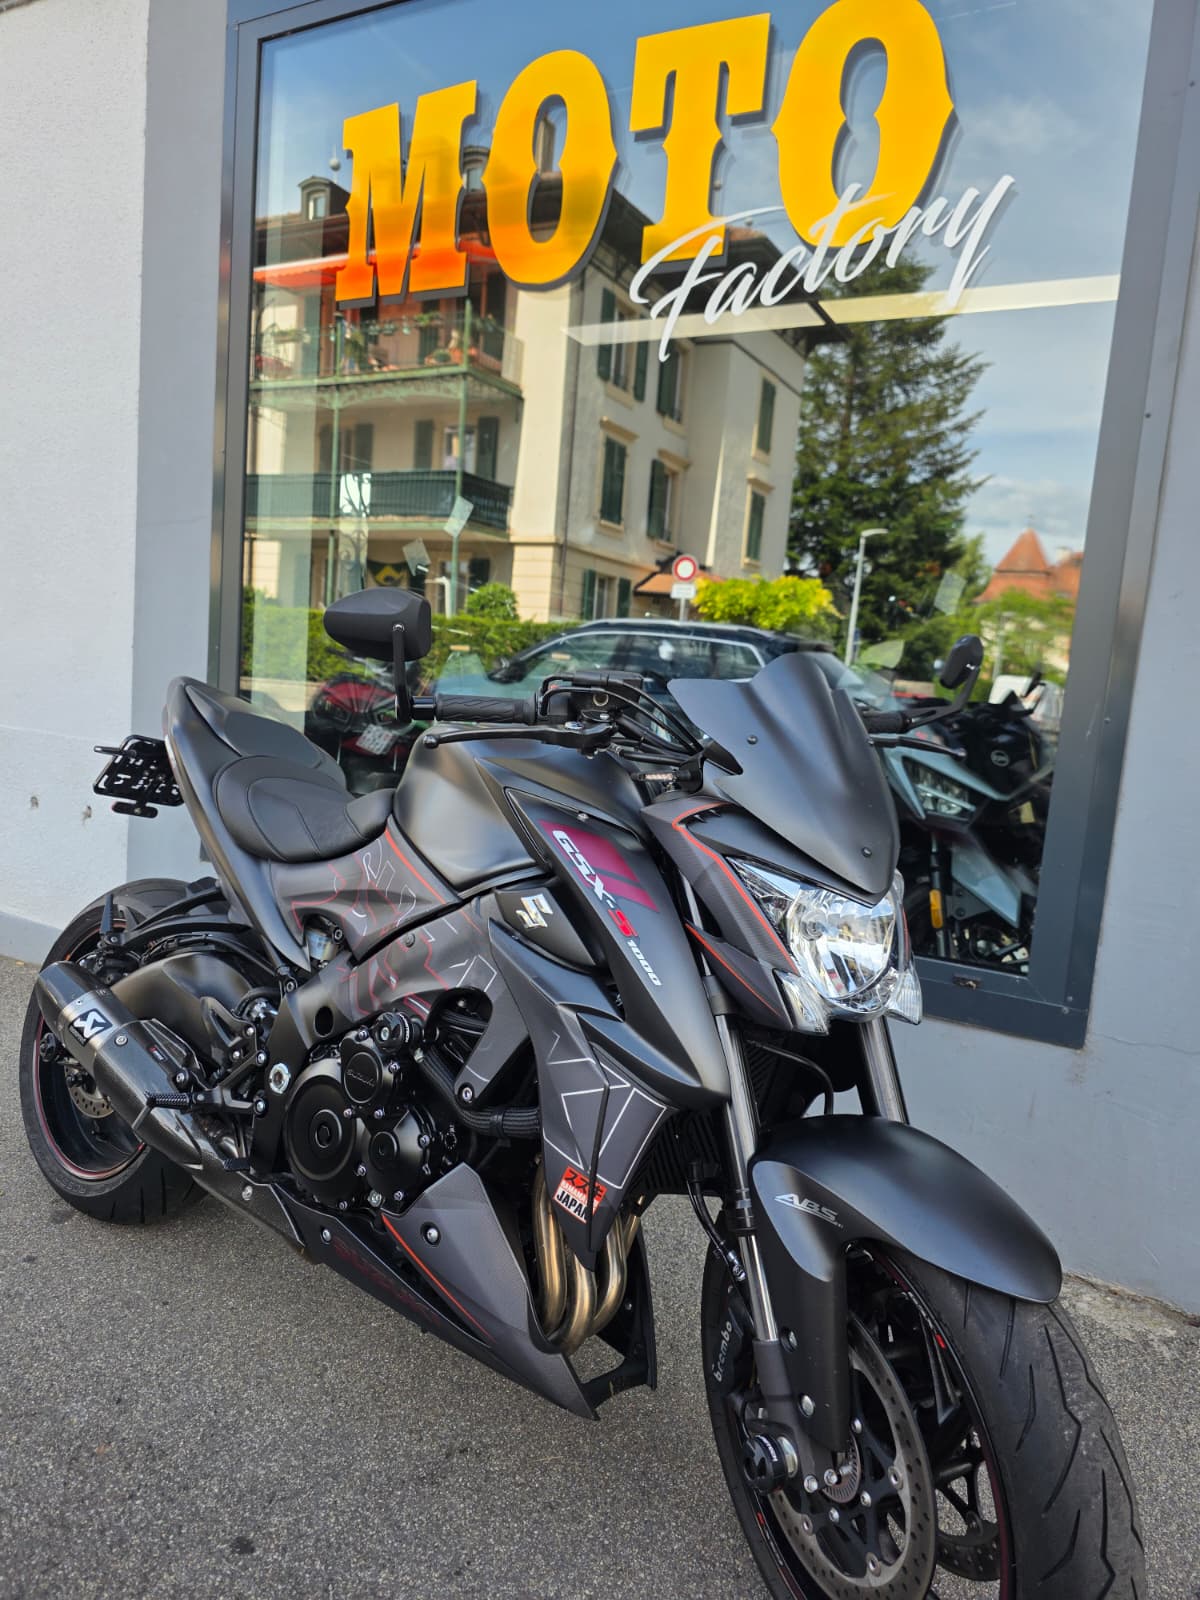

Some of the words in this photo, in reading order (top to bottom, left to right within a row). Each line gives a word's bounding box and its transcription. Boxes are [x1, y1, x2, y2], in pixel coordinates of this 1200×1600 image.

[334, 0, 957, 305] MOTO
[627, 175, 1016, 363] Factory
[627, 938, 663, 986] 1000
[774, 1193, 839, 1223] ABS
[713, 1321, 733, 1382] brembo
